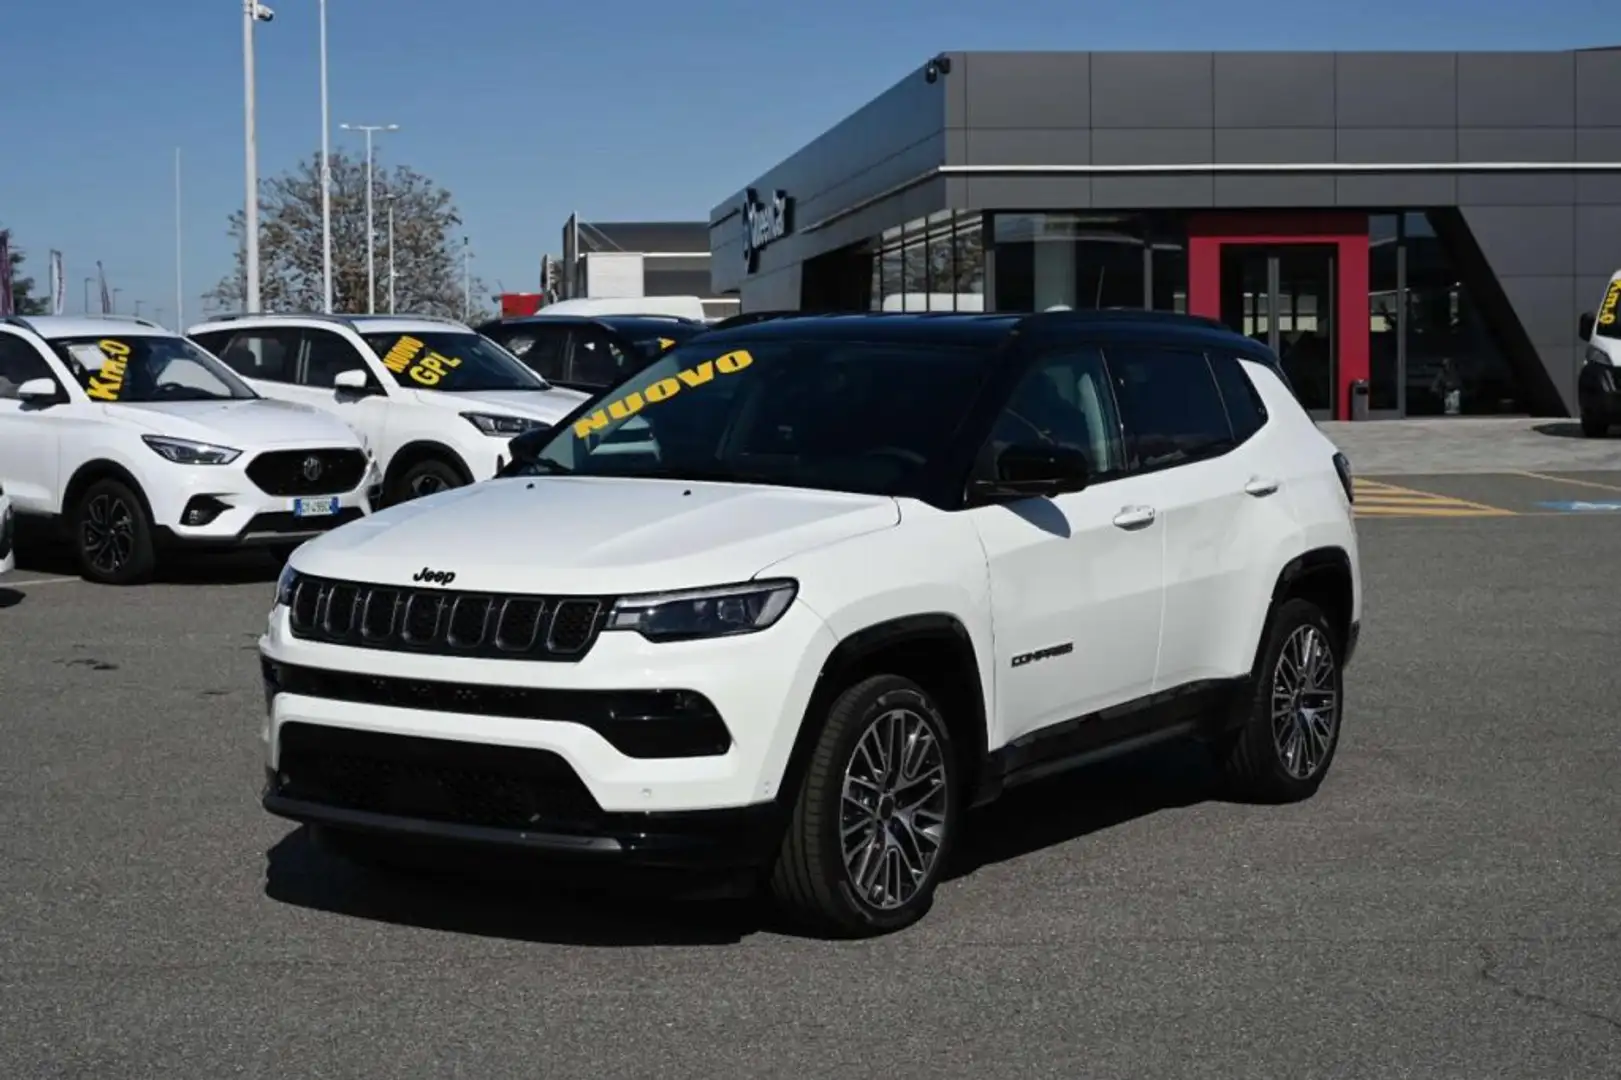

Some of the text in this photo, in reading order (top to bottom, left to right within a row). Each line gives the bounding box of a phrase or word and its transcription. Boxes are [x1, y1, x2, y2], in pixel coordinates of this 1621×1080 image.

[410, 352, 462, 385] GPL
[573, 350, 753, 438] NUOVO
[413, 567, 456, 586] Jeep
